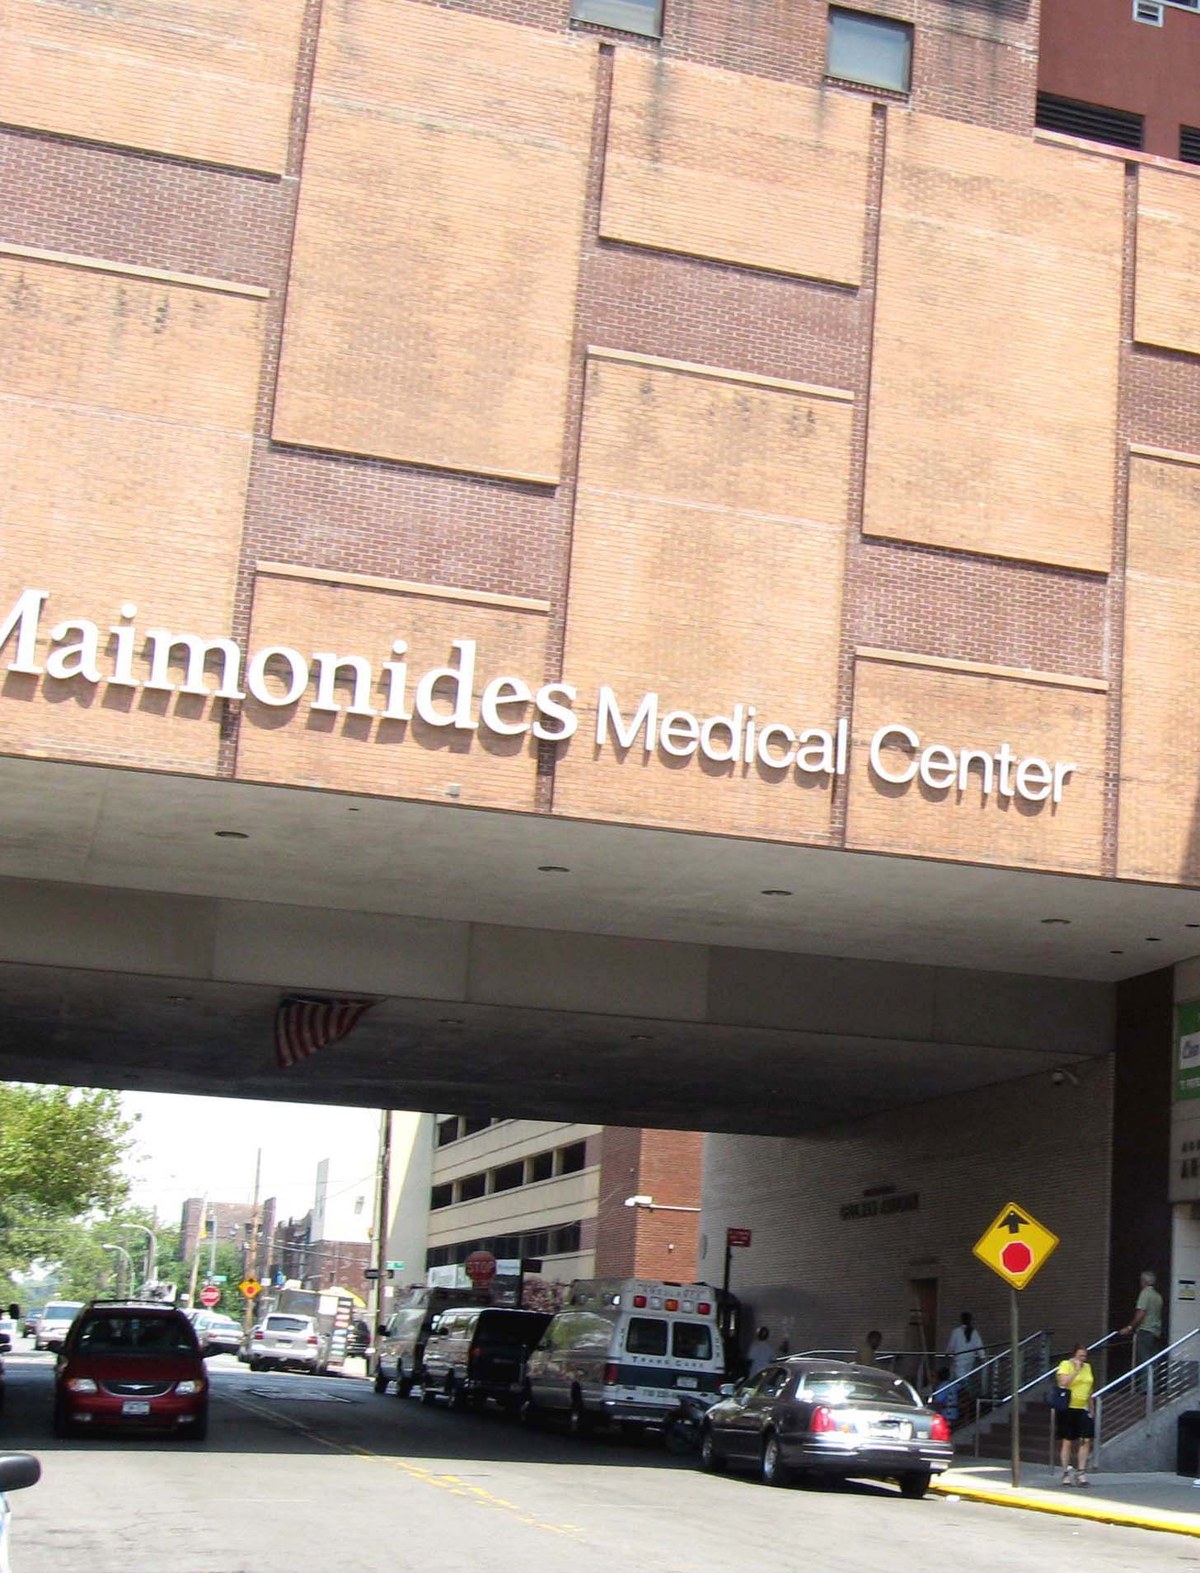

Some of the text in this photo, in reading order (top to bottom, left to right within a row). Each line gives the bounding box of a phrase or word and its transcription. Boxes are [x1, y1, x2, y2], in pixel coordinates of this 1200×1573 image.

[596, 686, 849, 775] Medical
[869, 724, 1077, 803] Center
[467, 1261, 495, 1273] STOP
